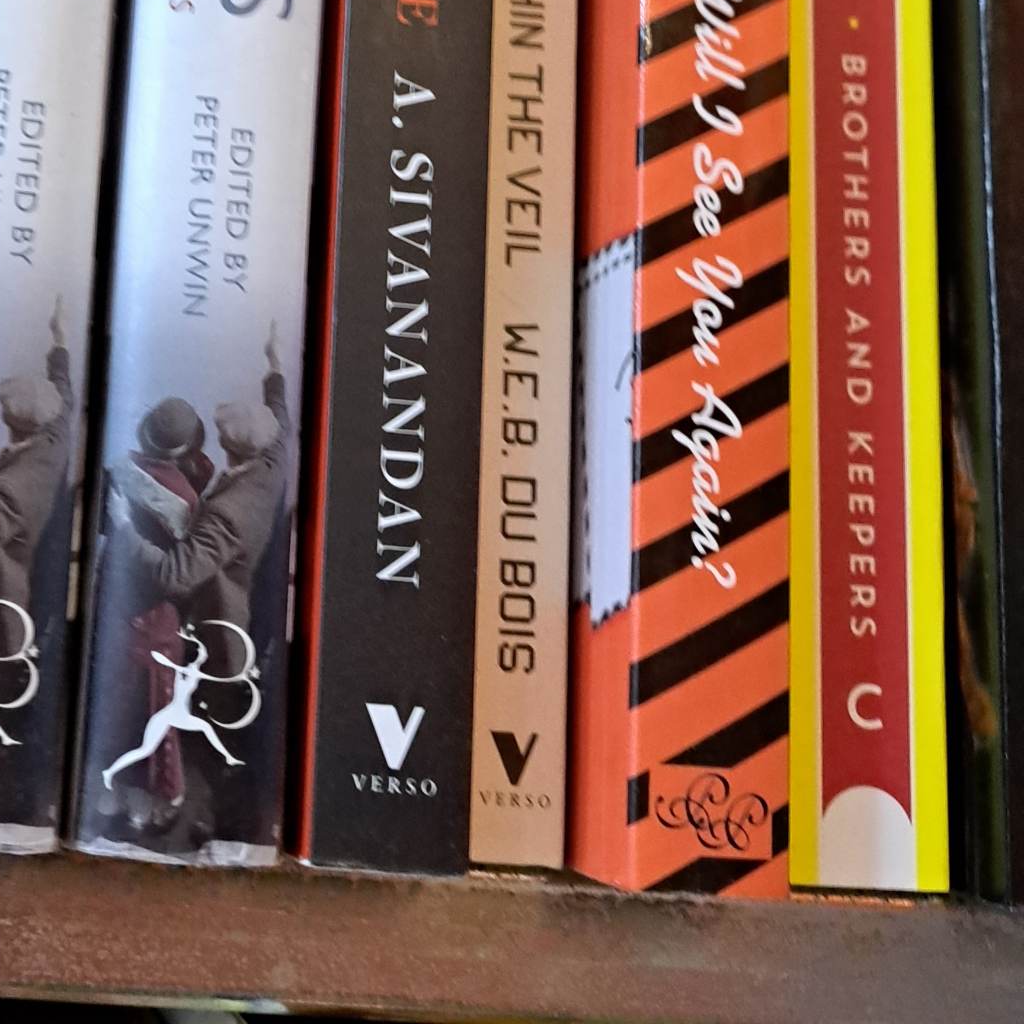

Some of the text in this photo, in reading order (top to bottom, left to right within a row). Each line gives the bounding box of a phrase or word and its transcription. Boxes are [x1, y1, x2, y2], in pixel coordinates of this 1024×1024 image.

[392, 69, 437, 130] A.
[507, 61, 545, 157] THE
[10, 101, 47, 267] EDITED BY
[180, 92, 220, 319] PETER UNWIN
[220, 126, 257, 295] EDITED BY
[504, 163, 543, 269] VEIL
[691, 143, 745, 239] See
[840, 54, 872, 287] BROTHERS
[375, 144, 435, 590] SIVANANDAN
[676, 255, 744, 371] You
[846, 309, 873, 406] AND
[502, 321, 541, 458] W.E.B.
[500, 476, 538, 543] DU
[673, 381, 745, 590] Again?
[847, 433, 876, 638] KEEPERS
[498, 559, 536, 674] BOIS
[351, 772, 438, 798] VERSO
[478, 788, 553, 810] VERSO
